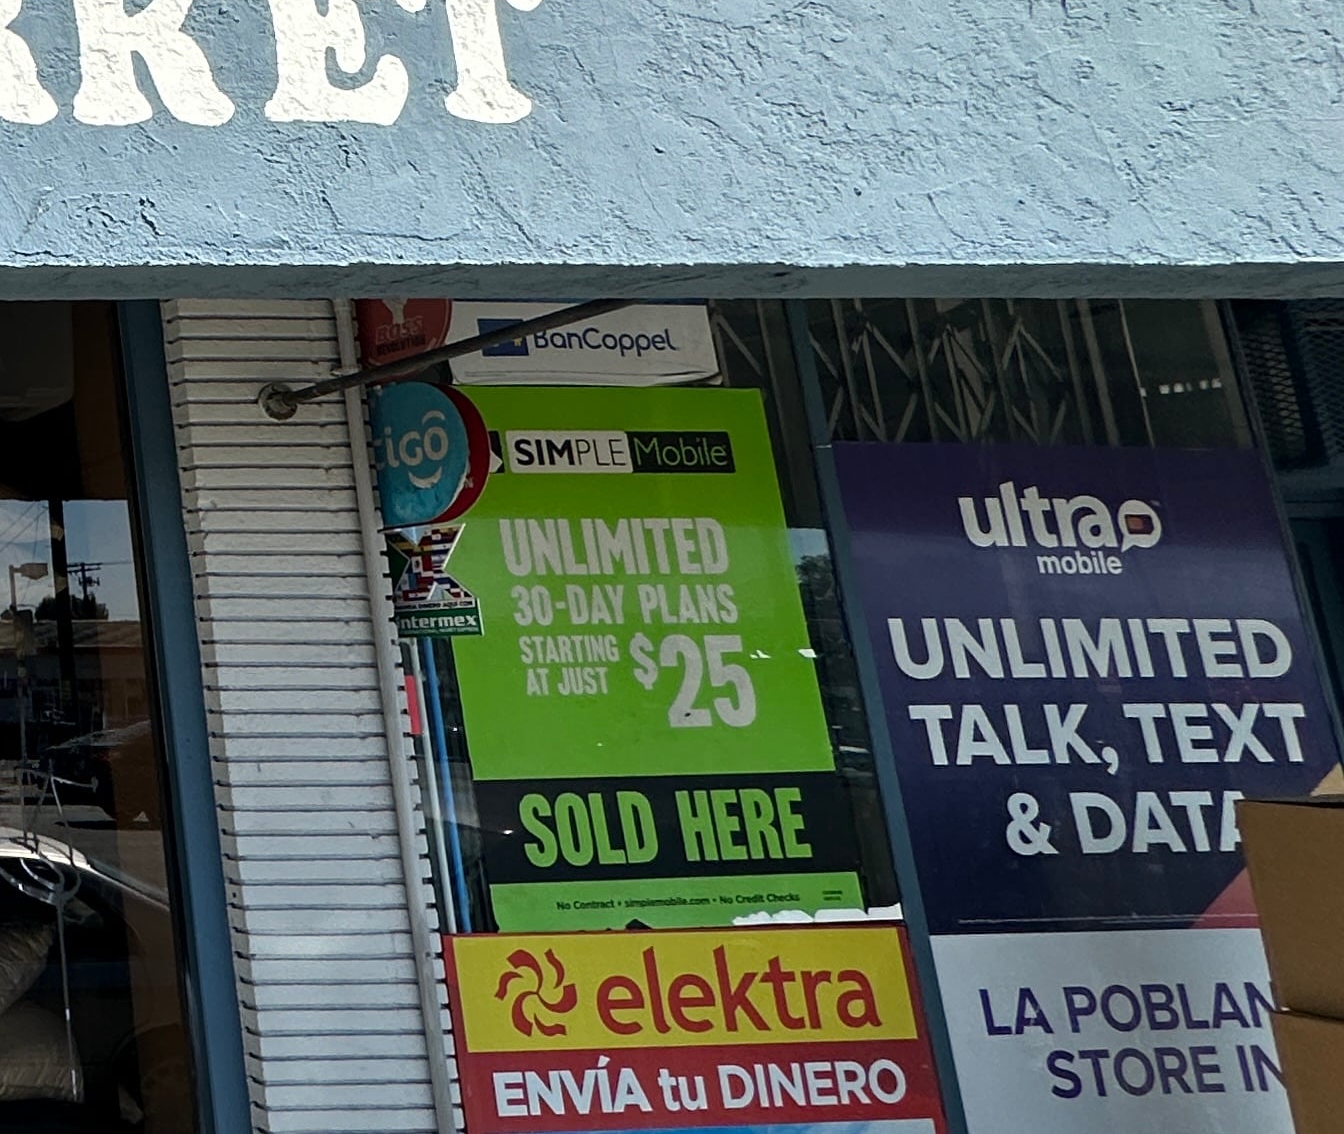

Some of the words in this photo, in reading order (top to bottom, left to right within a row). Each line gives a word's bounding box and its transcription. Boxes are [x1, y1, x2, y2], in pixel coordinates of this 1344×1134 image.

[533, 327, 676, 357] BanCoppel
[514, 438, 625, 466] SIMPLE
[634, 436, 728, 466] Mobile
[499, 517, 730, 577] UNLIMITED
[1036, 553, 1123, 575] mobile
[513, 584, 624, 626] 30-DAY
[640, 585, 738, 624] PLANS
[519, 635, 619, 663] STARTING
[887, 618, 1293, 679] UNLIMITED
[526, 669, 551, 696] AT
[557, 668, 609, 695] JUST
[629, 632, 758, 728] $25
[908, 703, 1118, 775] TALK,
[1123, 703, 1306, 763] TEXT
[519, 790, 659, 867] SOLD
[675, 787, 812, 863] HERE
[1006, 792, 1059, 856] &
[556, 900, 571, 910] No
[574, 899, 614, 910] Contract
[720, 895, 733, 905] No
[736, 894, 765, 904] Credit
[767, 892, 800, 903] Checks
[596, 945, 882, 1035] elektra
[979, 987, 1053, 1037] LA
[493, 1056, 651, 1117] ENVÍA
[658, 1070, 708, 1110] tu
[718, 1059, 907, 1110] DINERO
[1046, 1045, 1226, 1100] STORE
